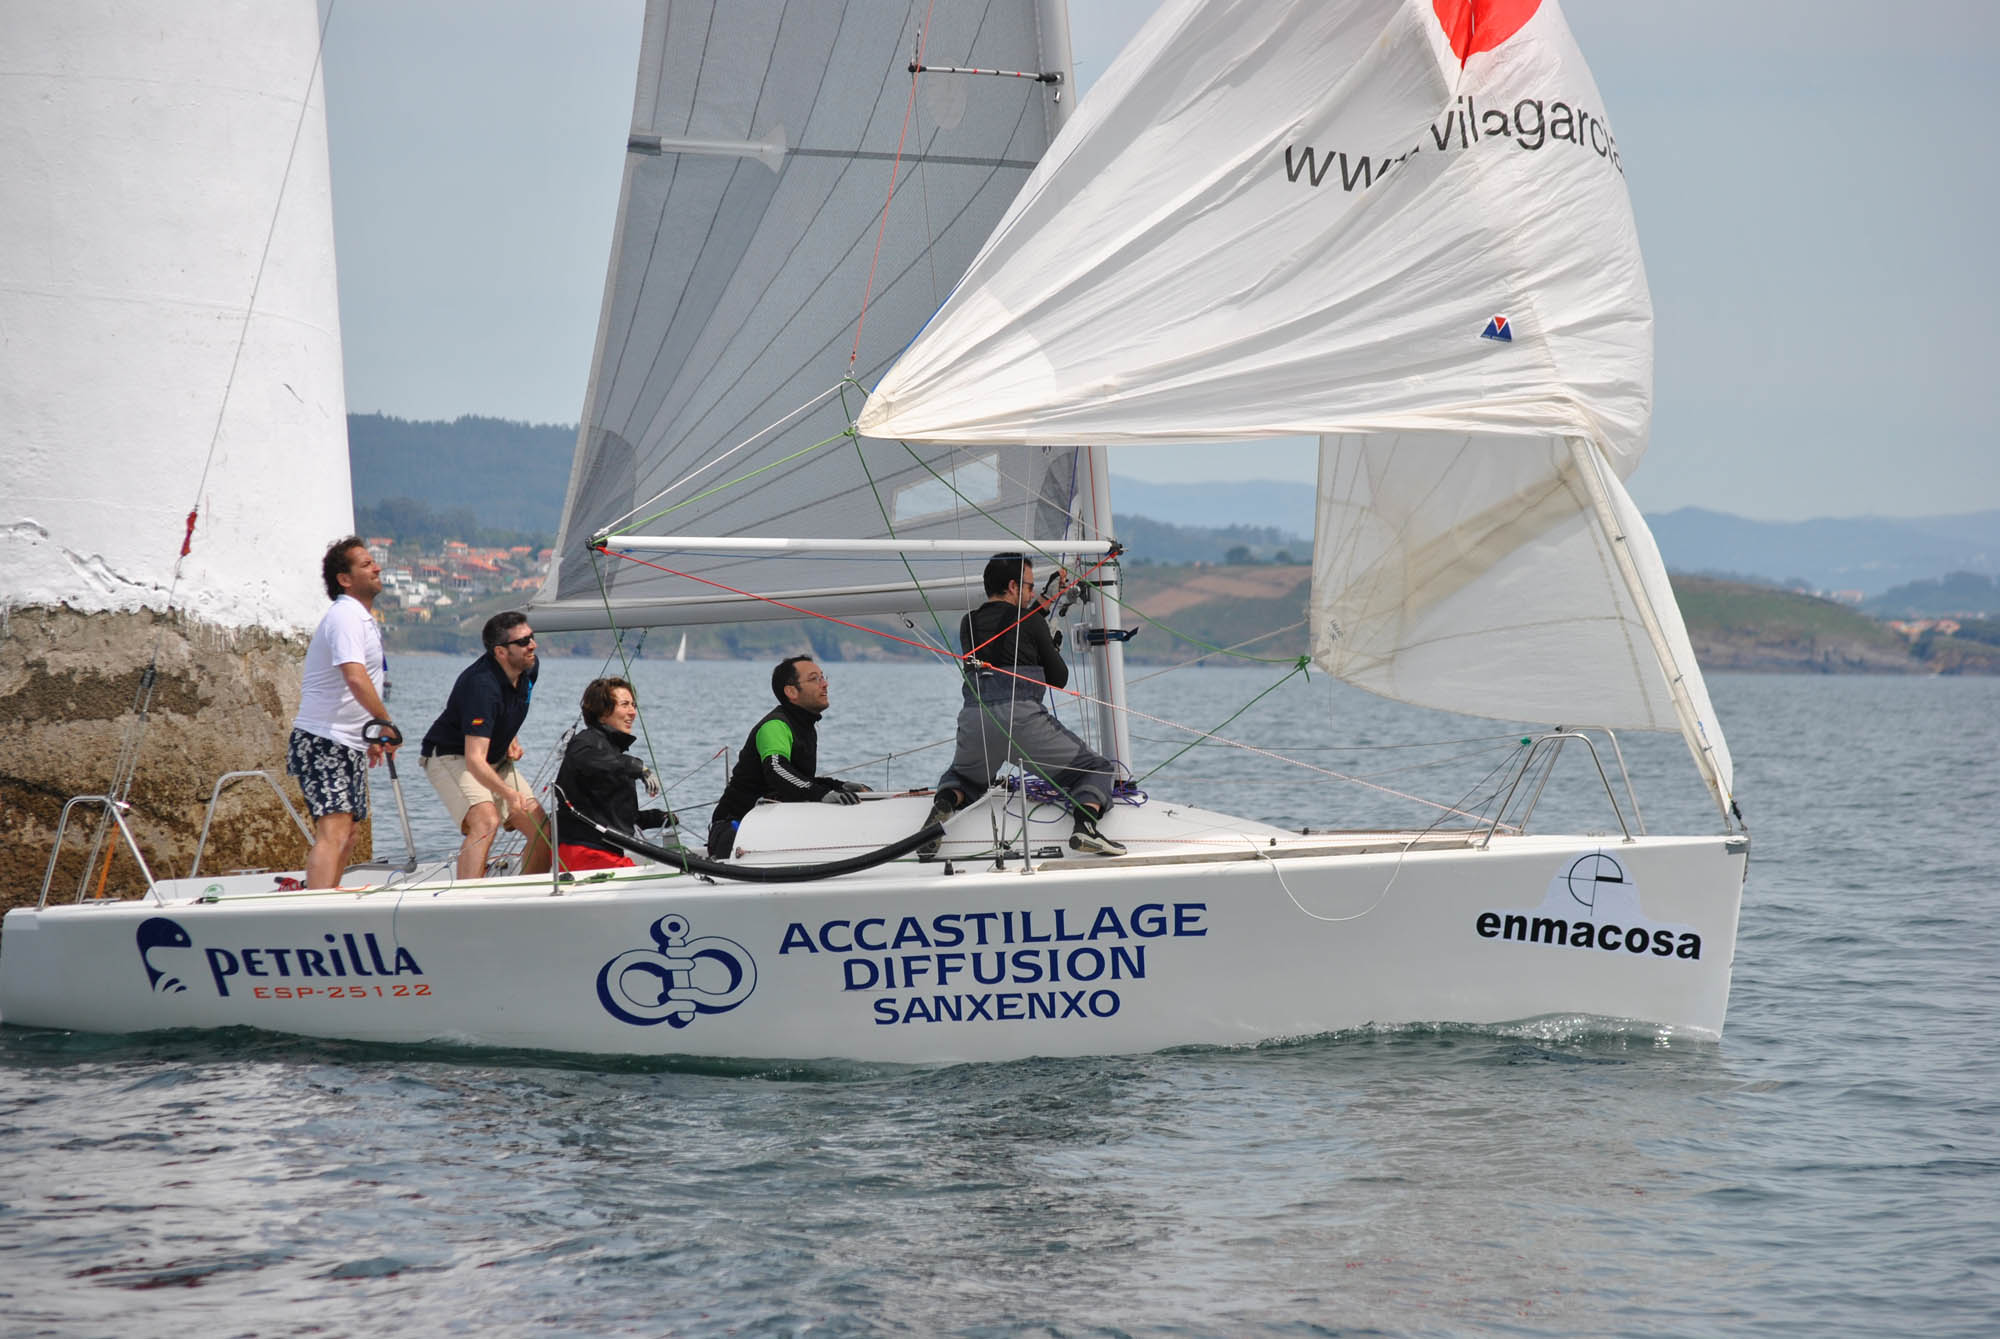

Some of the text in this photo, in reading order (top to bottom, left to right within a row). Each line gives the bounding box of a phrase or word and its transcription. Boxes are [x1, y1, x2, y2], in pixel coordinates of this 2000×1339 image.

[779, 903, 1208, 955] ACCASTILLAGE
[1476, 911, 1702, 960] enmacosa
[843, 945, 1147, 991] DIFFUSION
[254, 984, 432, 999] ESP-25122
[873, 989, 1121, 1025] SANXENXO
